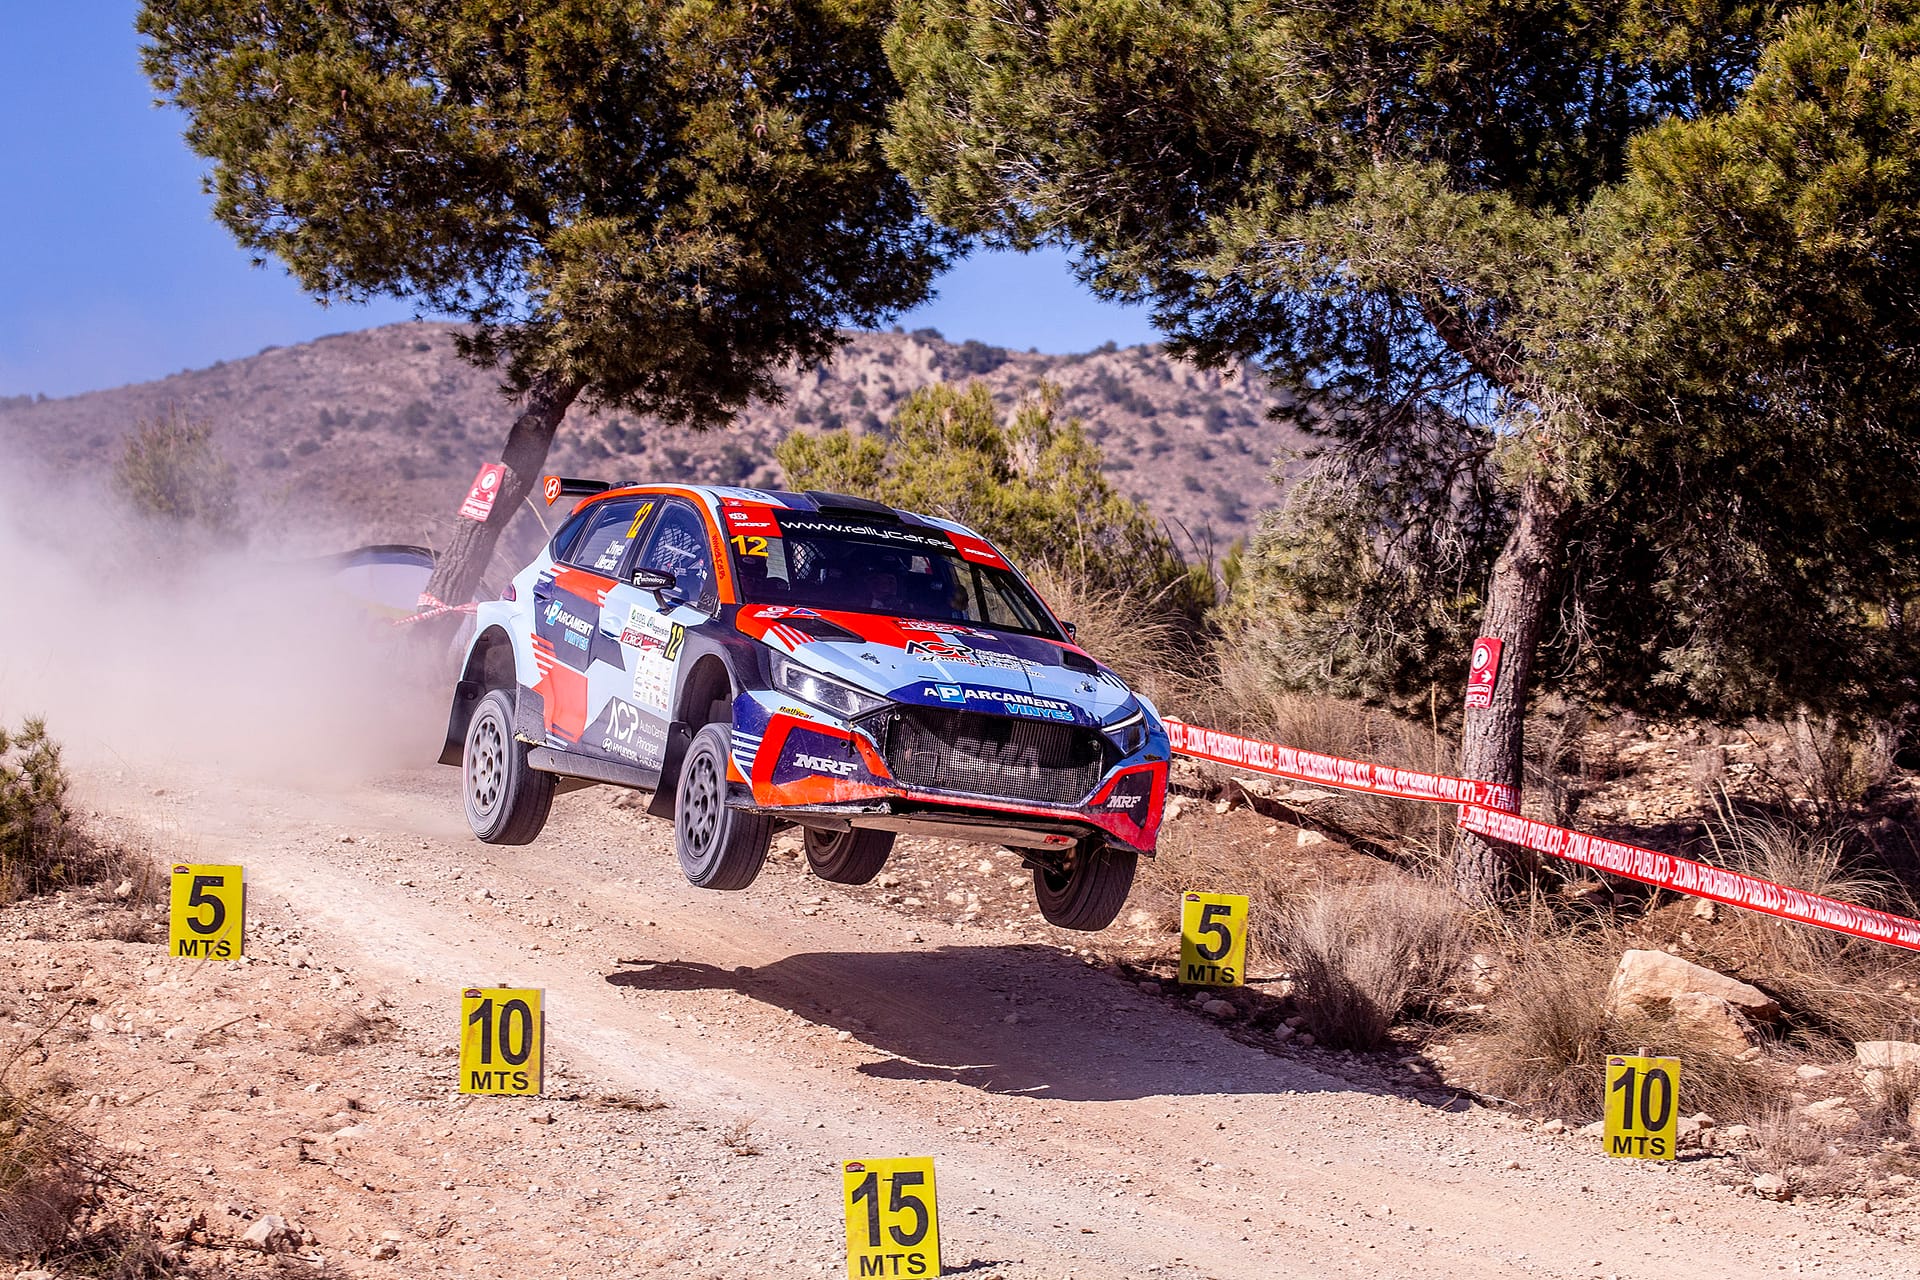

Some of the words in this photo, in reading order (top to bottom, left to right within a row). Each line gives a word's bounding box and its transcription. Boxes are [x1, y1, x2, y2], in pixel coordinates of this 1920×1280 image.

[626, 502, 653, 538] 12
[731, 535, 768, 557] 12
[780, 521, 956, 549] www.rallycar.es
[664, 624, 684, 660] 12
[779, 706, 815, 720] Rallycar
[1005, 702, 1075, 721] VINYES
[793, 753, 858, 775] MRF
[1187, 726, 1206, 753] ZONA
[1278, 746, 1298, 774] ZONA
[1375, 766, 1396, 792] ZONA
[1439, 777, 1475, 802] PUBLICO
[1484, 784, 1516, 811] ZONA
[1107, 796, 1141, 808] MRF
[1465, 805, 1487, 834] ZONA
[1487, 810, 1529, 846] PROHIBIDO
[1528, 821, 1563, 855] PUBLICO
[1564, 833, 1589, 862] ZONA
[1588, 839, 1634, 874] PROHIBIDO
[1633, 850, 1670, 882] PUBLICO
[1672, 860, 1698, 890] ZONA
[1697, 866, 1744, 902] PROHIBIDO
[1743, 878, 1780, 910] PUBLICO
[1782, 889, 1809, 917] ZONA
[1806, 895, 1856, 929] PROHIBIDO
[1851, 907, 1894, 938] PUBLICO
[187, 875, 225, 934] 5
[1196, 904, 1232, 960] 5
[179, 939, 231, 957] MTS
[1187, 964, 1235, 983] MTS
[469, 999, 533, 1066] 10
[471, 1071, 529, 1090] MTS
[1613, 1067, 1672, 1132] 10
[1613, 1136, 1666, 1156] MTS
[852, 1171, 929, 1247] 15
[860, 1253, 927, 1277] MTS
